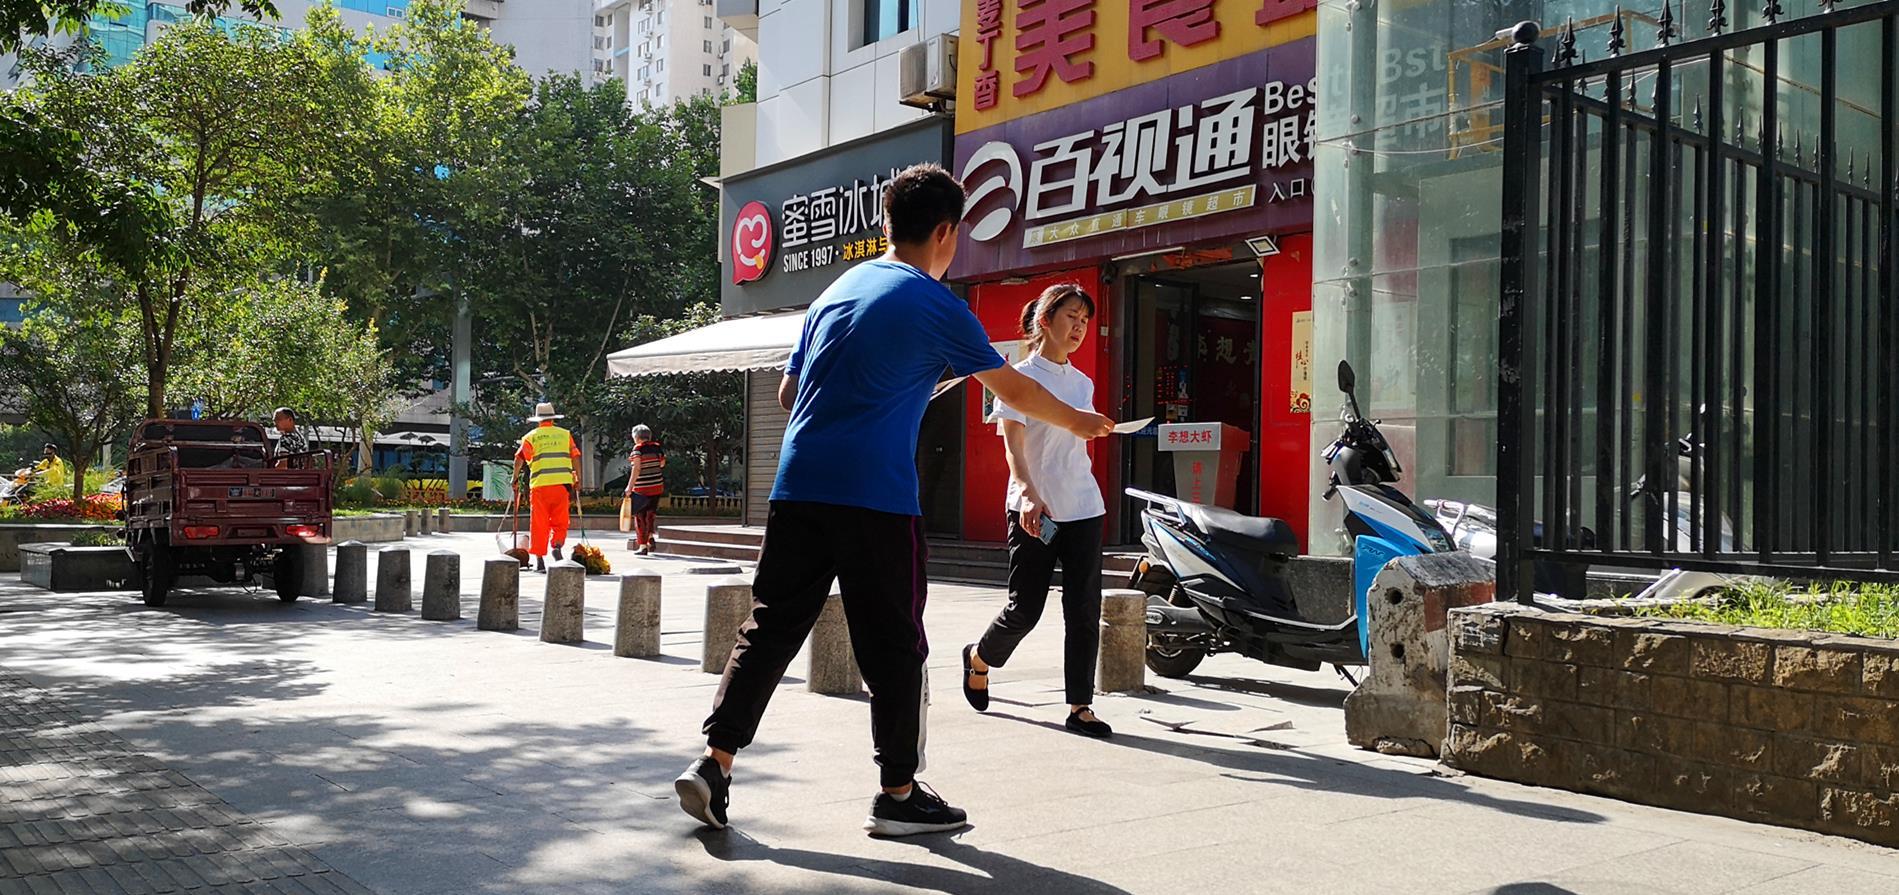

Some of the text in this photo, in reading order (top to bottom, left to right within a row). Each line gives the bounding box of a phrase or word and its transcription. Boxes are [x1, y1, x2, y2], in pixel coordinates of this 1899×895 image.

[1023, 87, 1257, 220] 百视通
[783, 250, 809, 273] SINCE
[811, 245, 834, 267] 1997
[1168, 430, 1213, 444] 李想大虾
